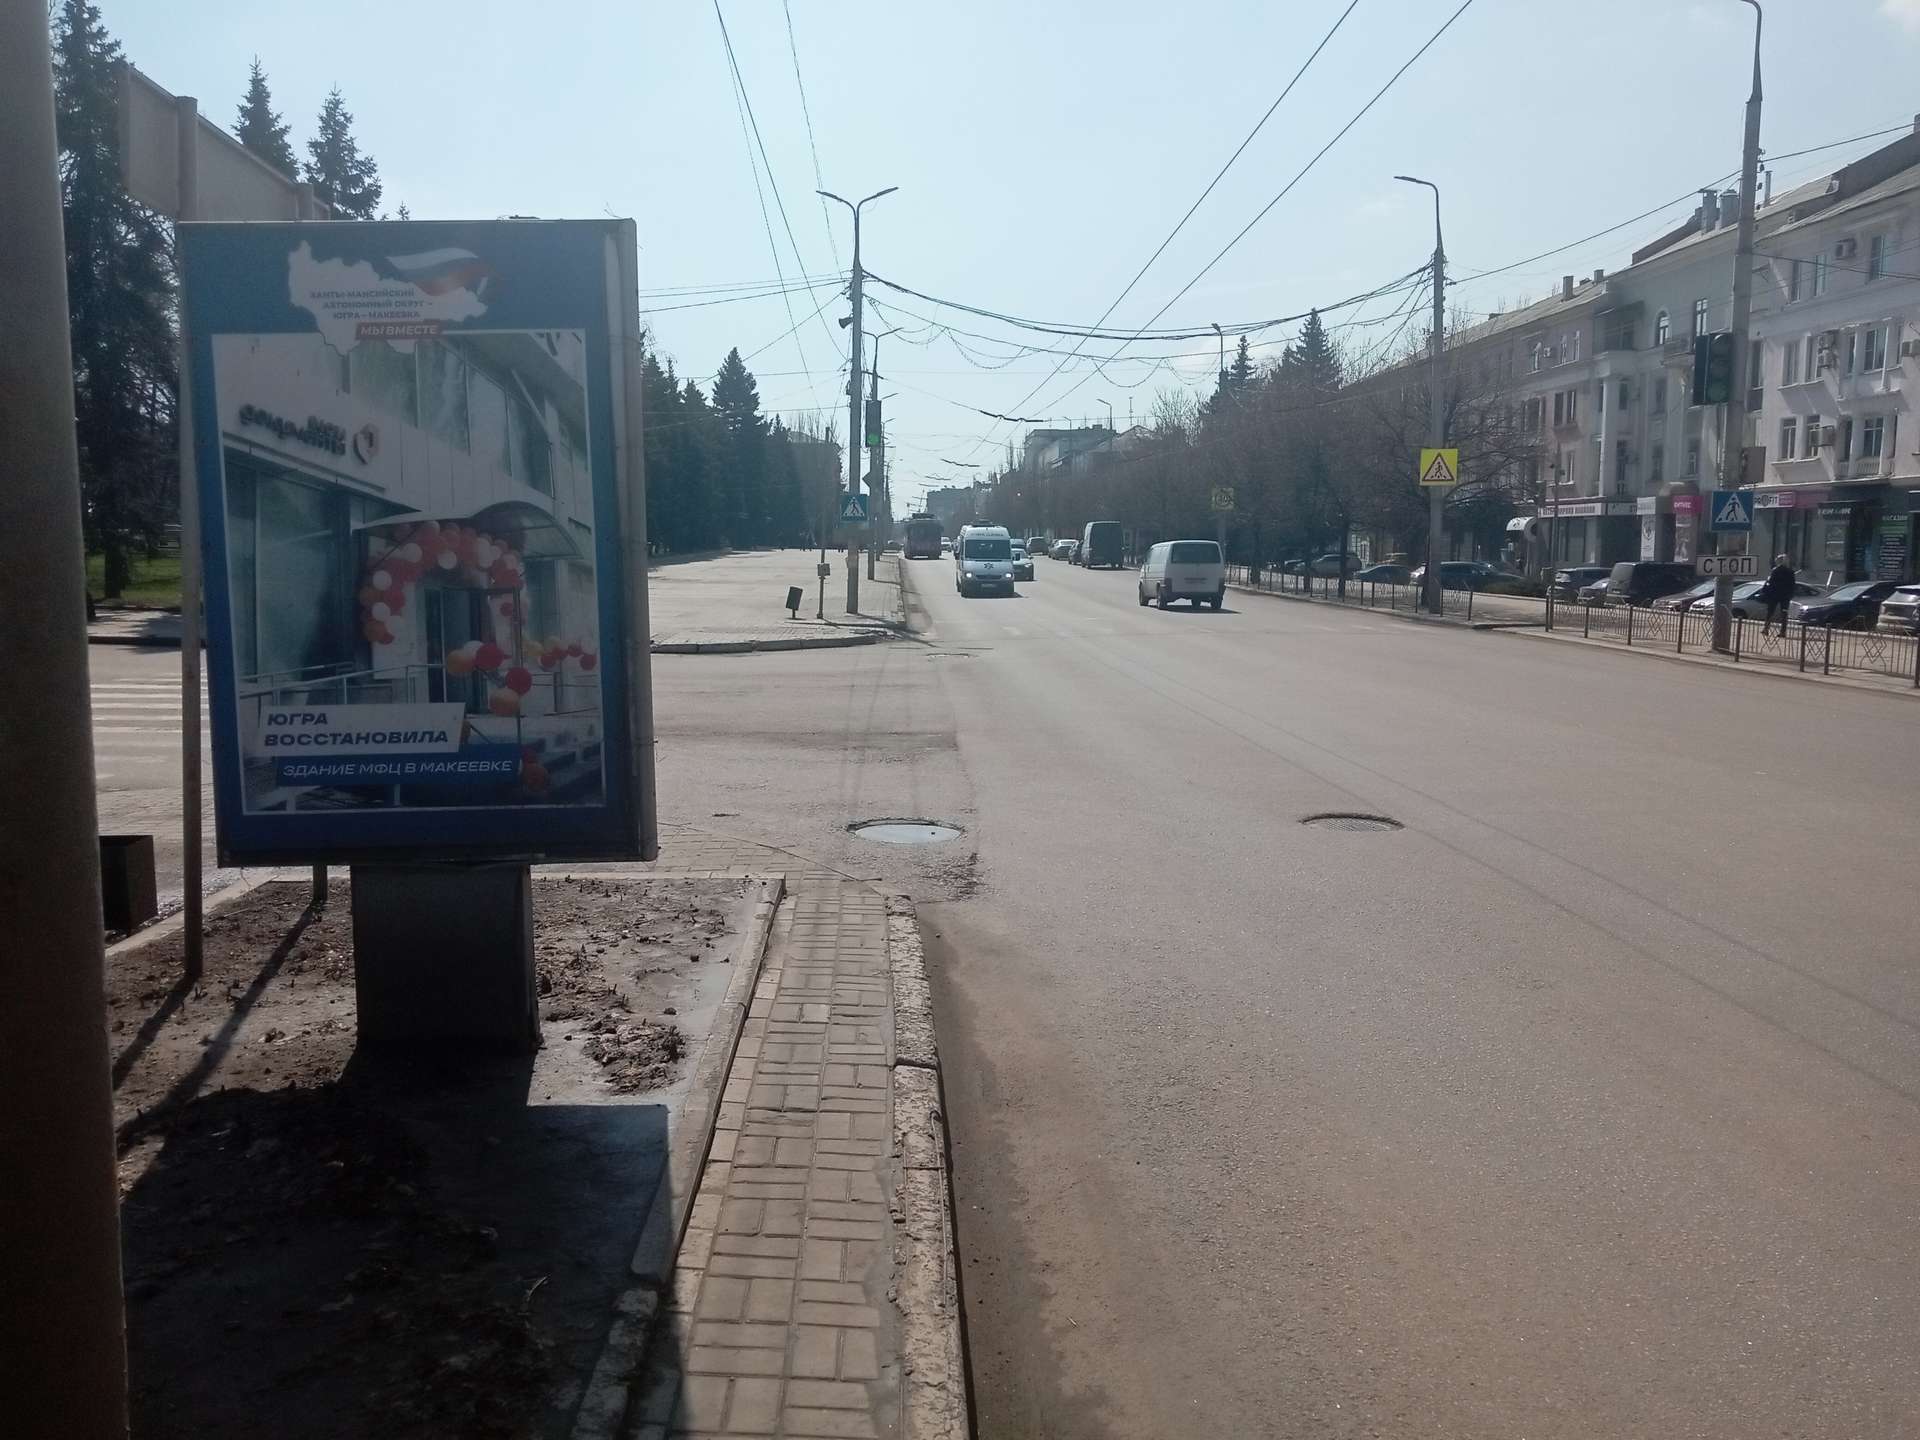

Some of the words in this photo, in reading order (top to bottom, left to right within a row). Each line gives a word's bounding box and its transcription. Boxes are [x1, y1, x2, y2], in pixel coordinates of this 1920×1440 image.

[310, 288, 415, 298] ХАНТЫ-МАНСИЙСКИЙ
[323, 301, 392, 309] АВТОНОМНЫЙ
[394, 300, 424, 308] ОКРУГ
[1703, 558, 1752, 573] СТОП
[267, 713, 328, 726] ЮГРА
[264, 731, 448, 746] ВОССТАНОВИЛА
[283, 764, 354, 777] ЗДАНИЕ
[359, 763, 400, 775] МФЦ
[404, 762, 416, 773] В
[419, 761, 512, 774] МАКЕЕВКЕ
